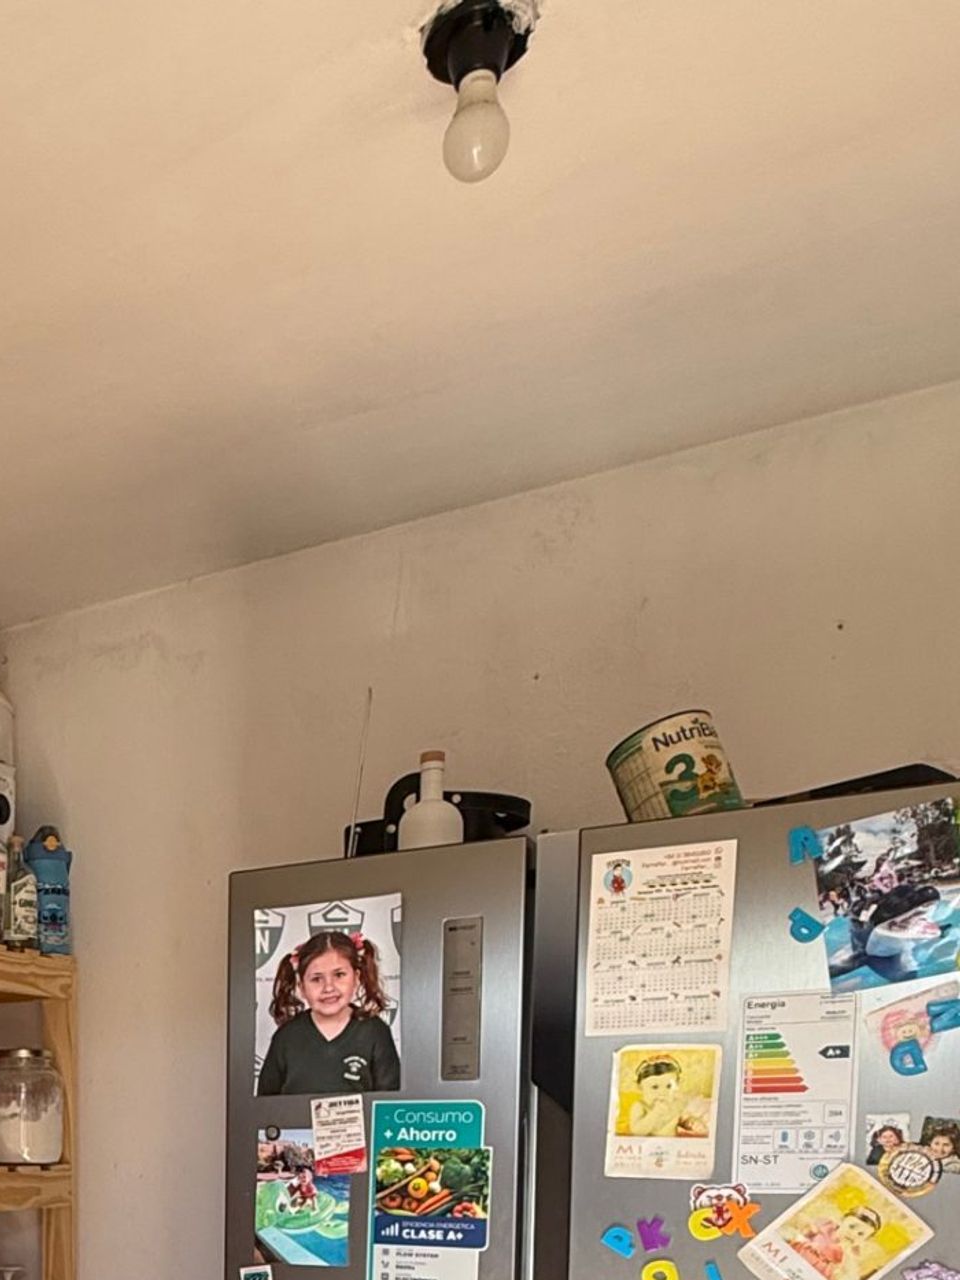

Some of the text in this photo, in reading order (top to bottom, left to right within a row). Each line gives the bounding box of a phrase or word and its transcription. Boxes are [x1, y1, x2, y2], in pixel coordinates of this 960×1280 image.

[393, 1108, 474, 1124] Consumo
[396, 1126, 457, 1142] Ahorro
[740, 1154, 780, 1166] SN-ST
[401, 1229, 464, 1241] CLASE A+
[637, 1216, 671, 1253] K
